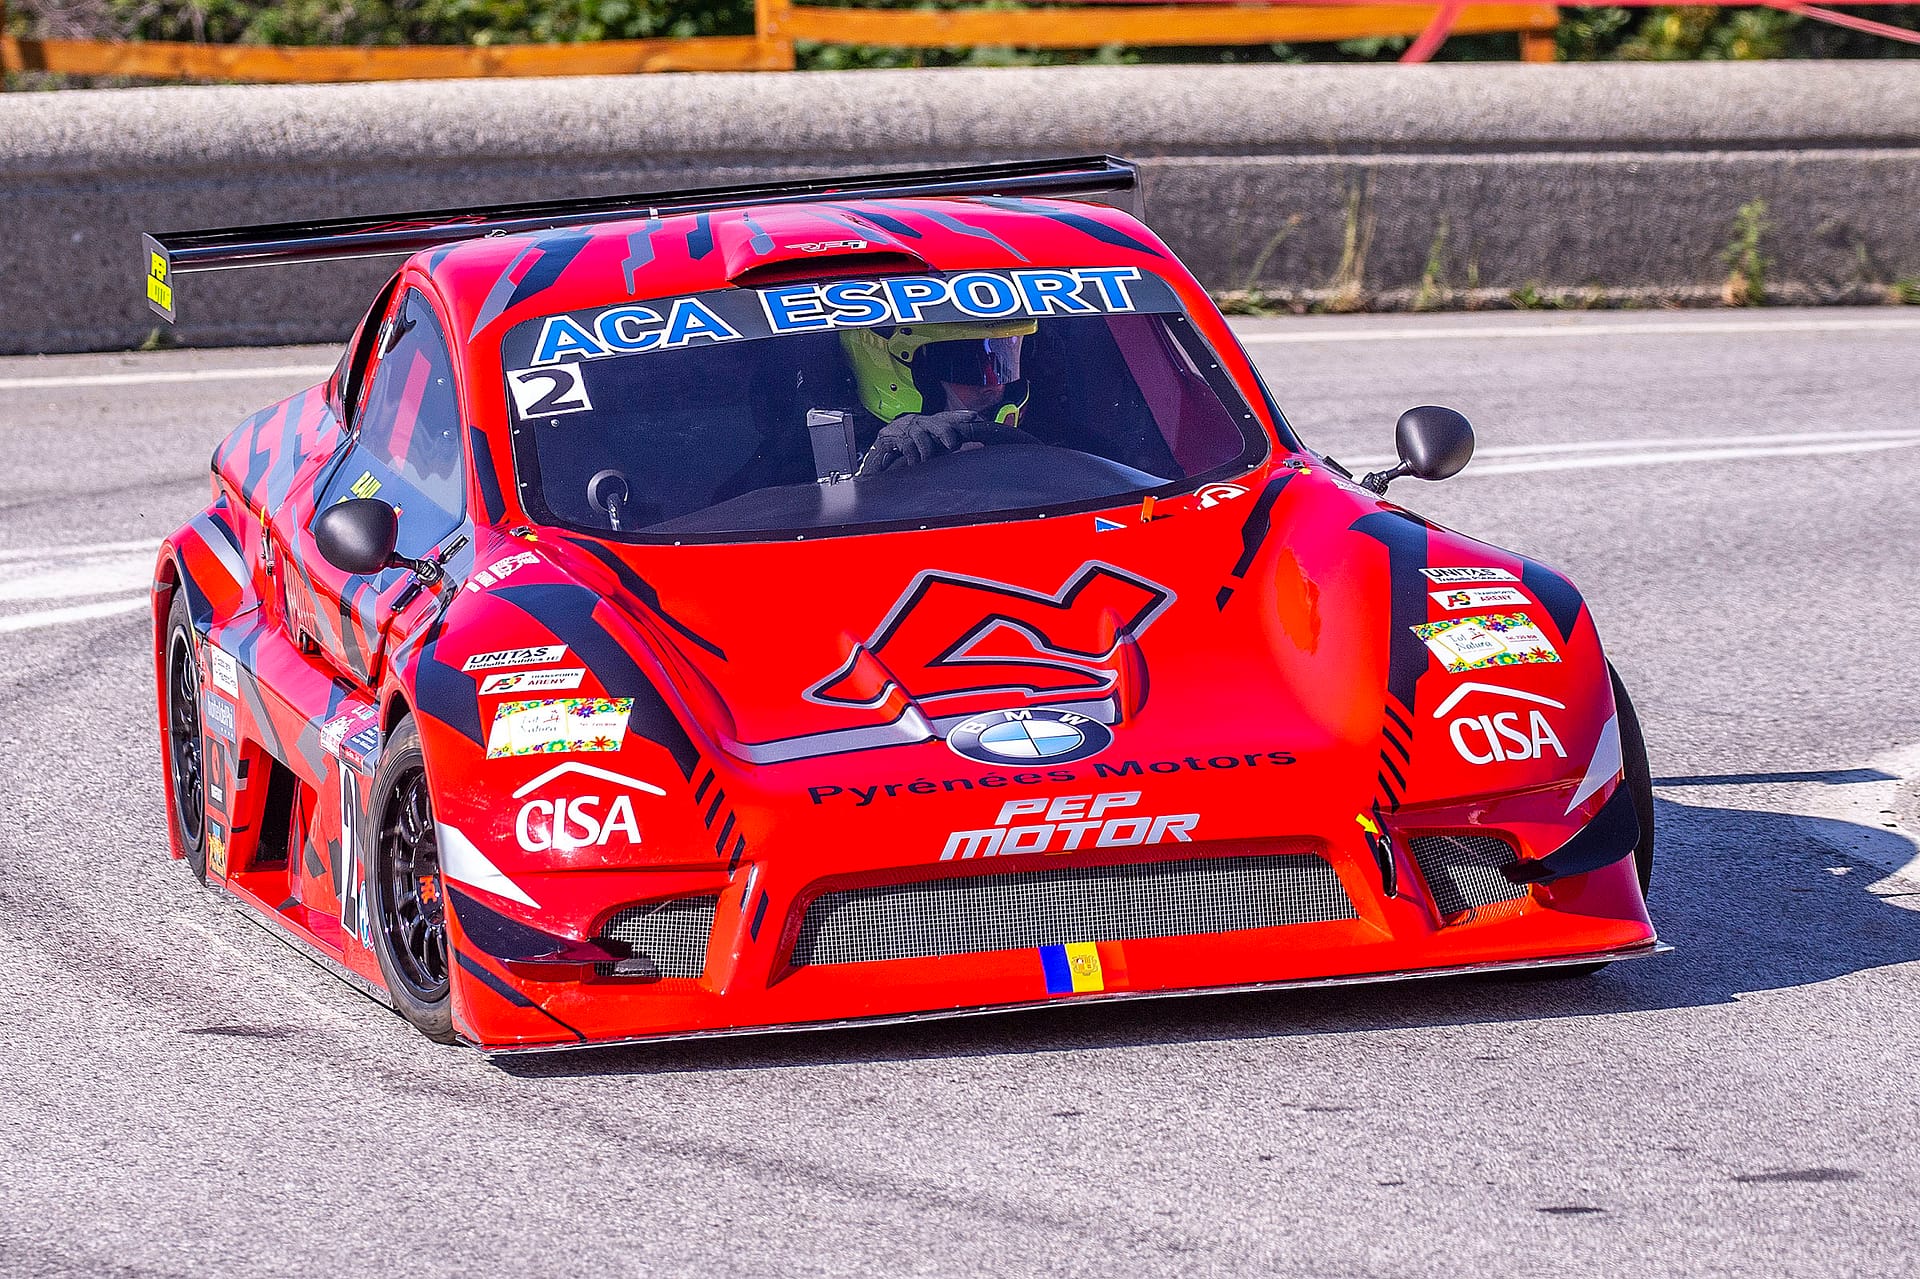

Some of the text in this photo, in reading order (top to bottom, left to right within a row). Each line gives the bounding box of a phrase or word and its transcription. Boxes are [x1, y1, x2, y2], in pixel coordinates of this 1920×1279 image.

[530, 266, 1142, 366] ACA ESPORT
[516, 368, 586, 415] 2
[1424, 568, 1497, 577] UNITAS
[470, 647, 549, 664] UNITAS
[527, 678, 566, 686] ARENY
[965, 709, 1090, 733] BMW
[1449, 710, 1568, 765] CISA
[807, 748, 1297, 806] Pyrénées Motors
[515, 795, 642, 853] CISA
[995, 791, 1142, 825] PEP
[939, 813, 1201, 861] MOTOR
